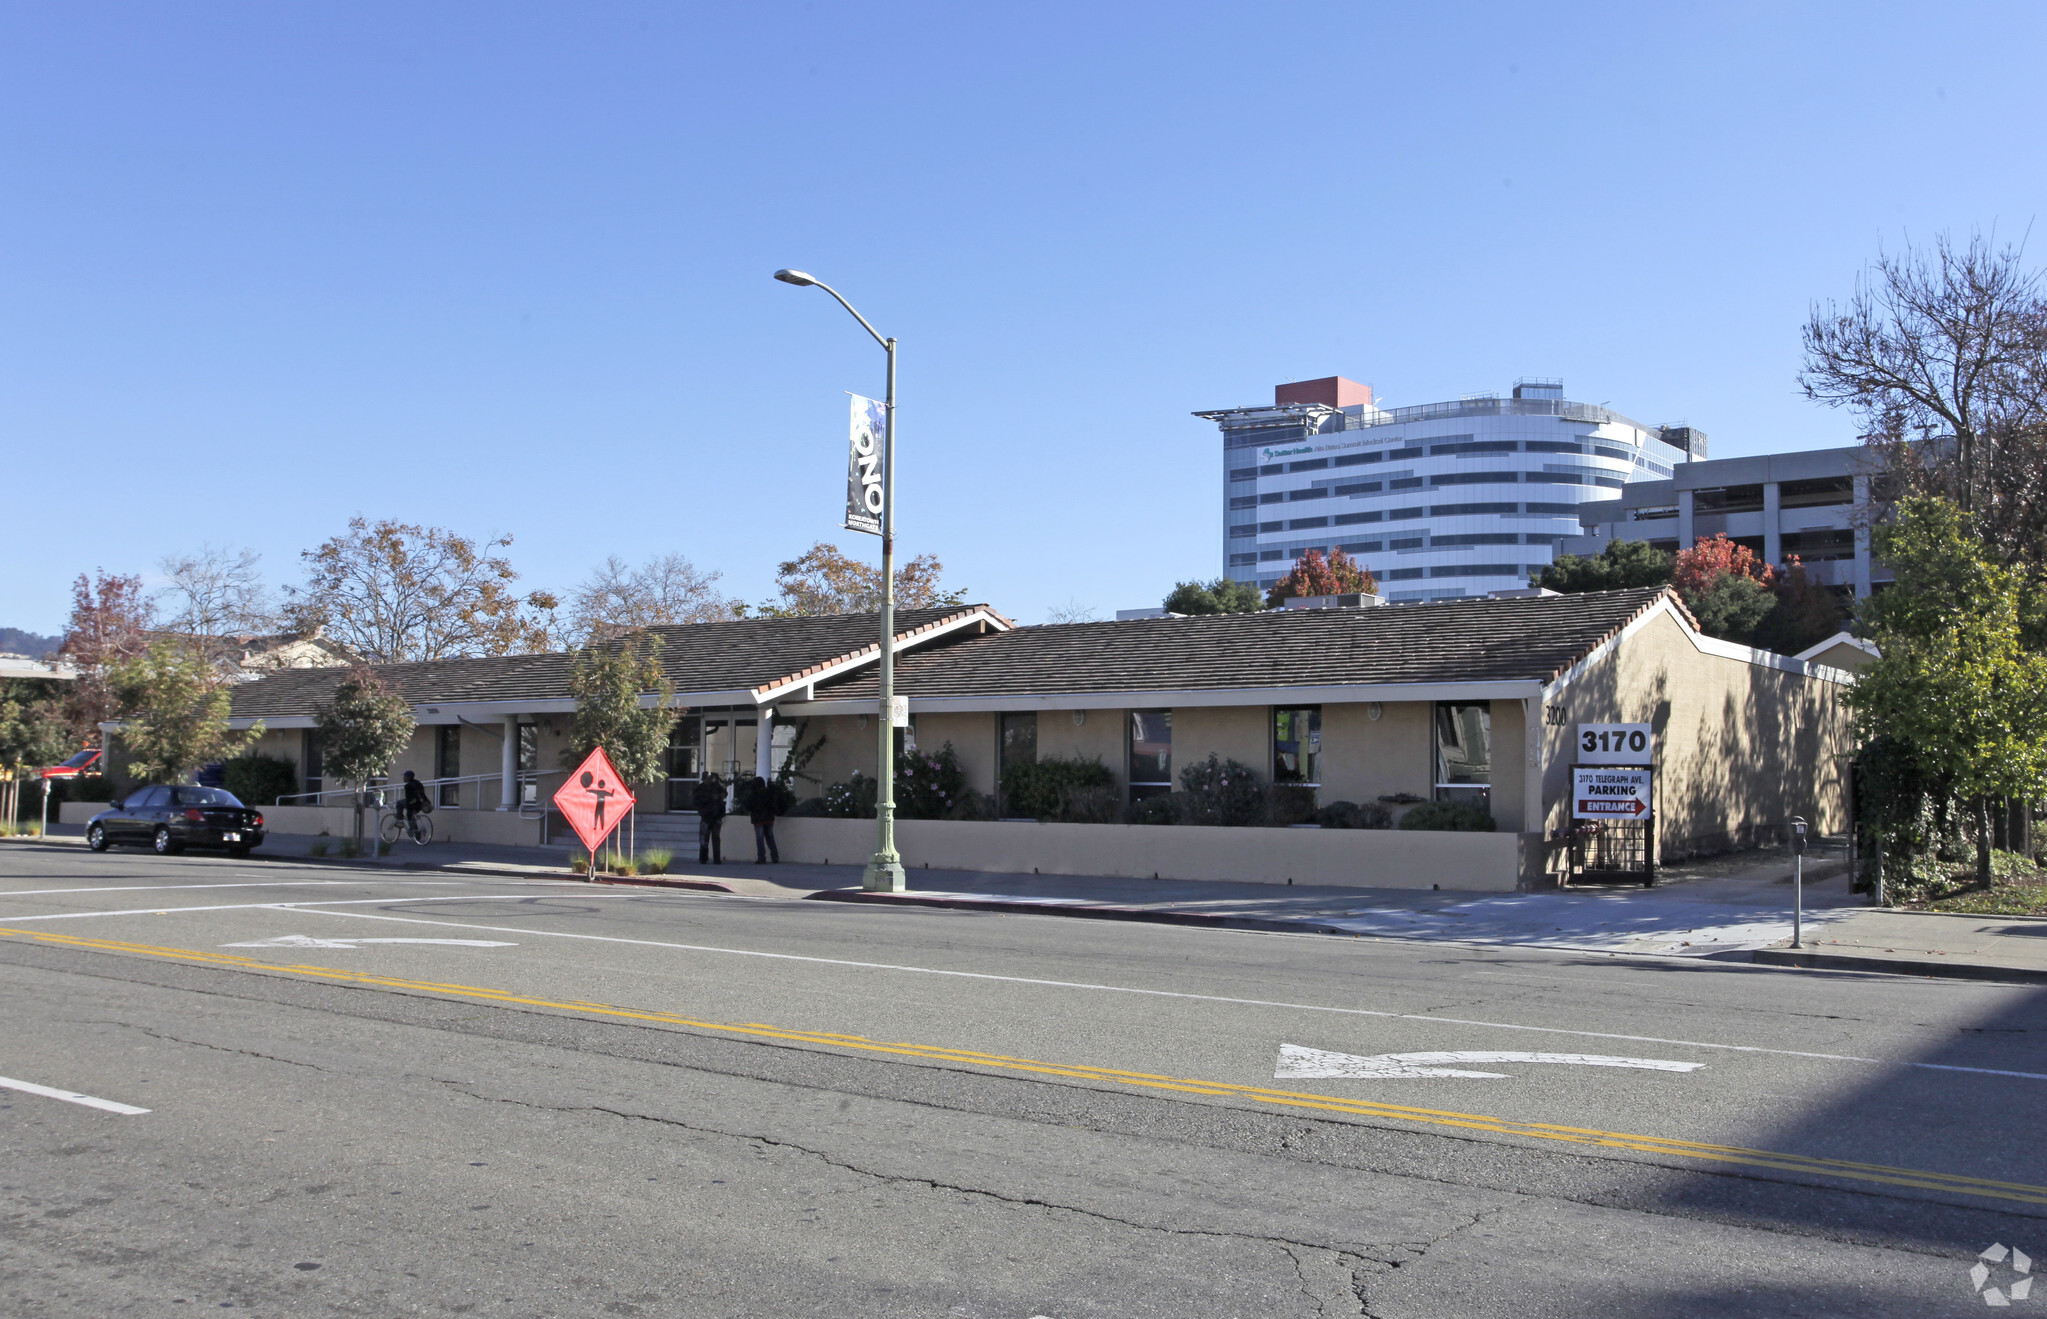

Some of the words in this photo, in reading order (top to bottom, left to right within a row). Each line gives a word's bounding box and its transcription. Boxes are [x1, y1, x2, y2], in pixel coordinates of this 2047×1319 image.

[848, 514, 879, 525] KOREATOWN
[848, 520, 879, 531] NORTHGATE
[1545, 705, 1567, 726] 3200
[1582, 730, 1646, 752] 3170
[1578, 775, 1593, 783] 3170
[1595, 775, 1629, 784] TELEGRAPH
[1631, 776, 1644, 784] AVE.
[1588, 785, 1637, 795] PARKING
[1587, 801, 1636, 811] ENTRANCE
